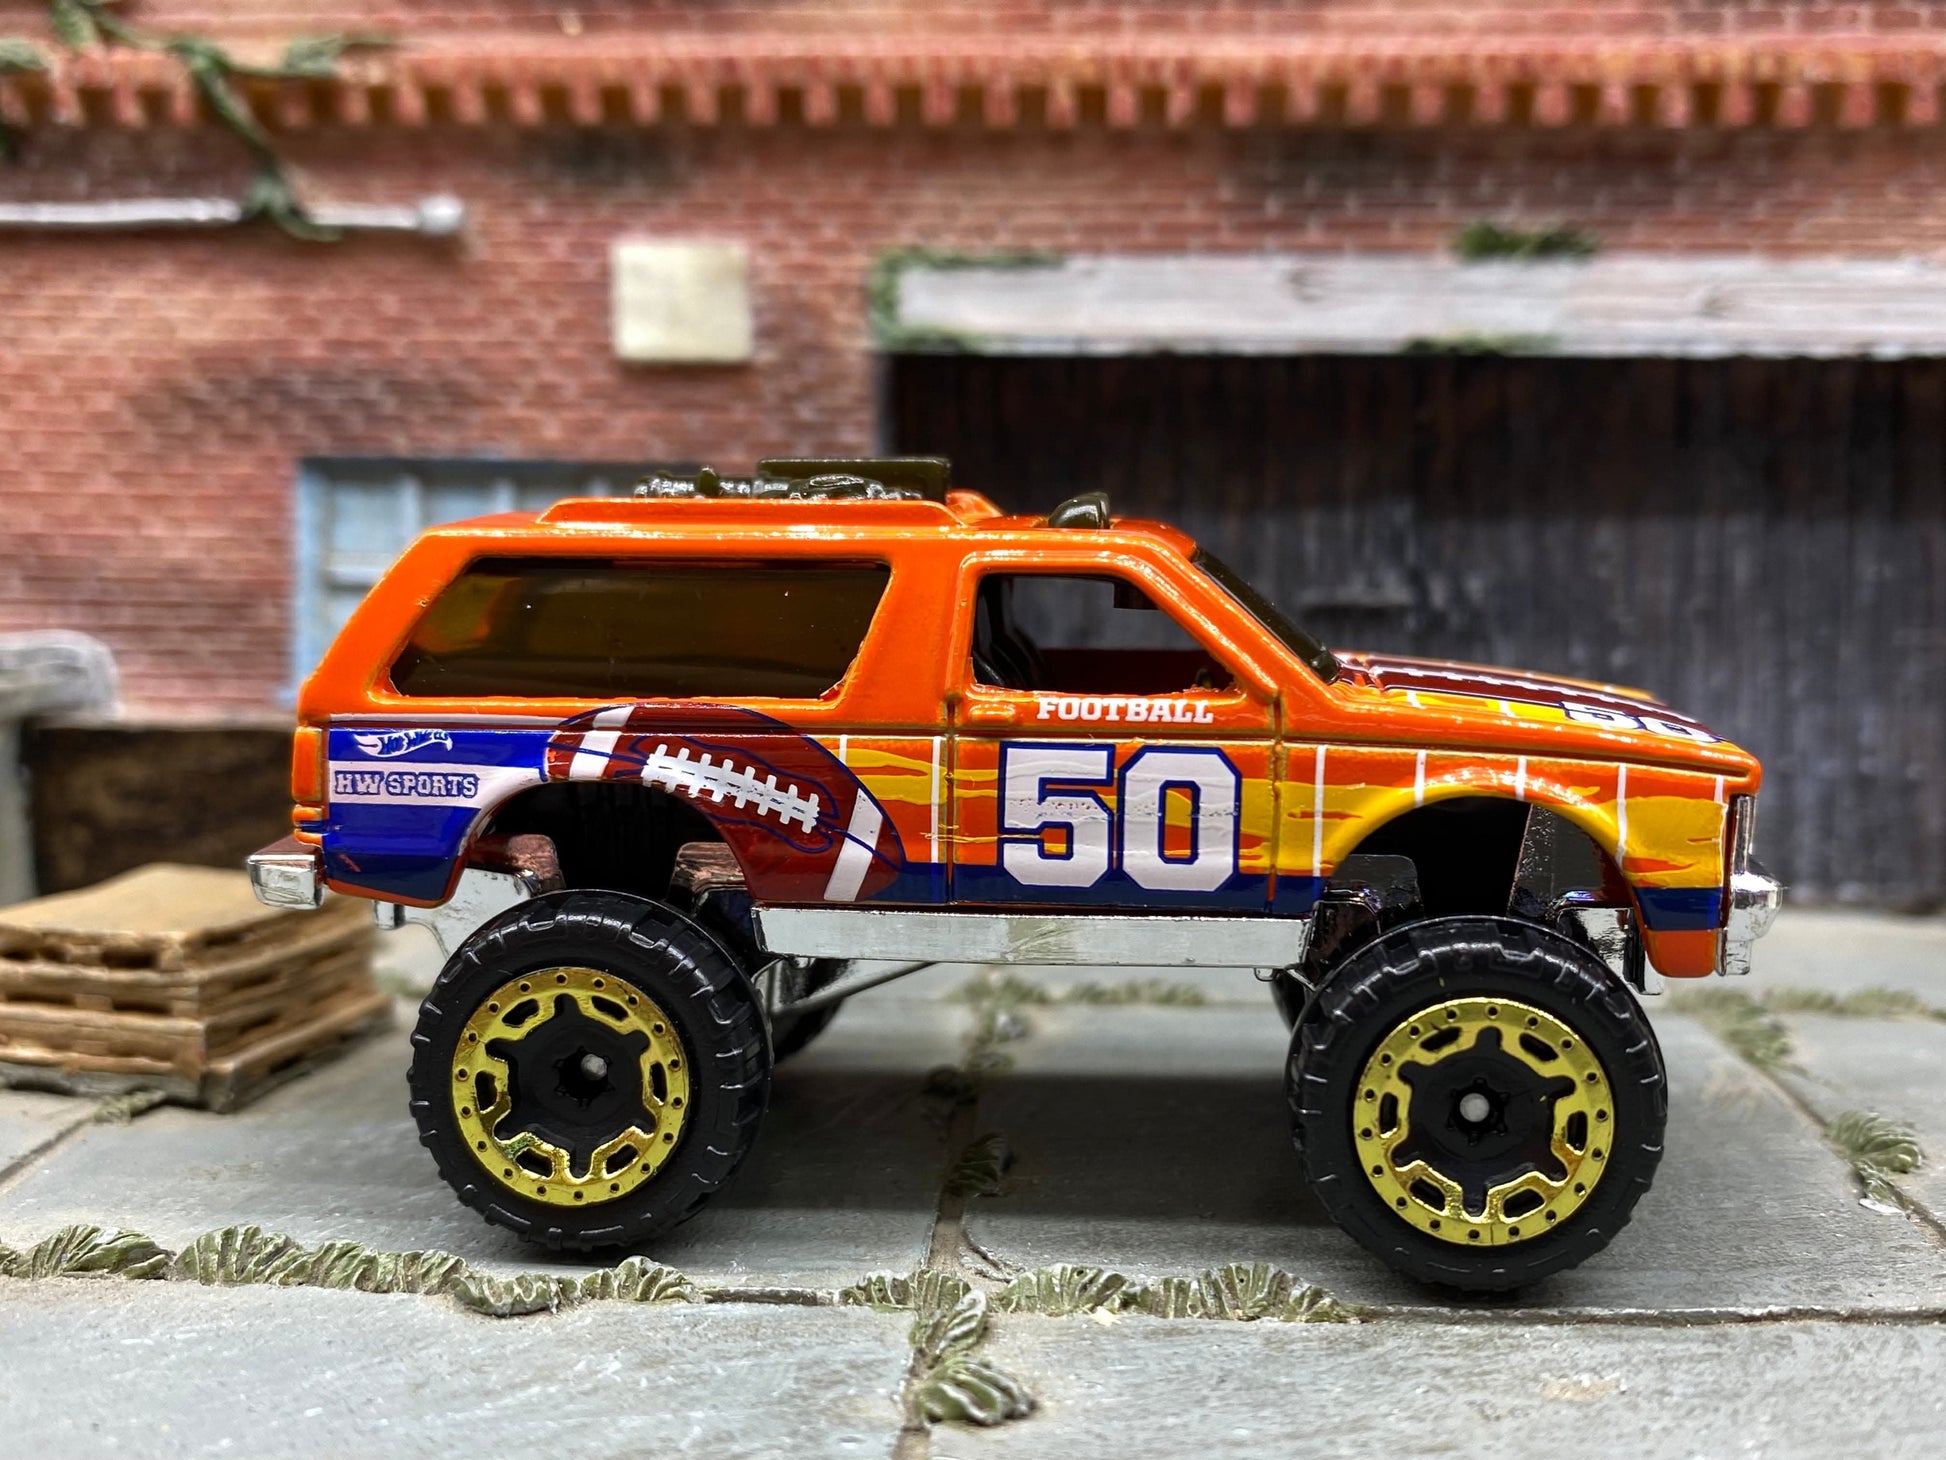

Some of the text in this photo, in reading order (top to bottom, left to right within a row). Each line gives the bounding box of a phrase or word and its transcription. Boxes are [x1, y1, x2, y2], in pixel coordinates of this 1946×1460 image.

[1036, 697, 1214, 724] FOOTBALL
[334, 771, 480, 799] HW SPORTS
[999, 743, 1241, 893] 50
